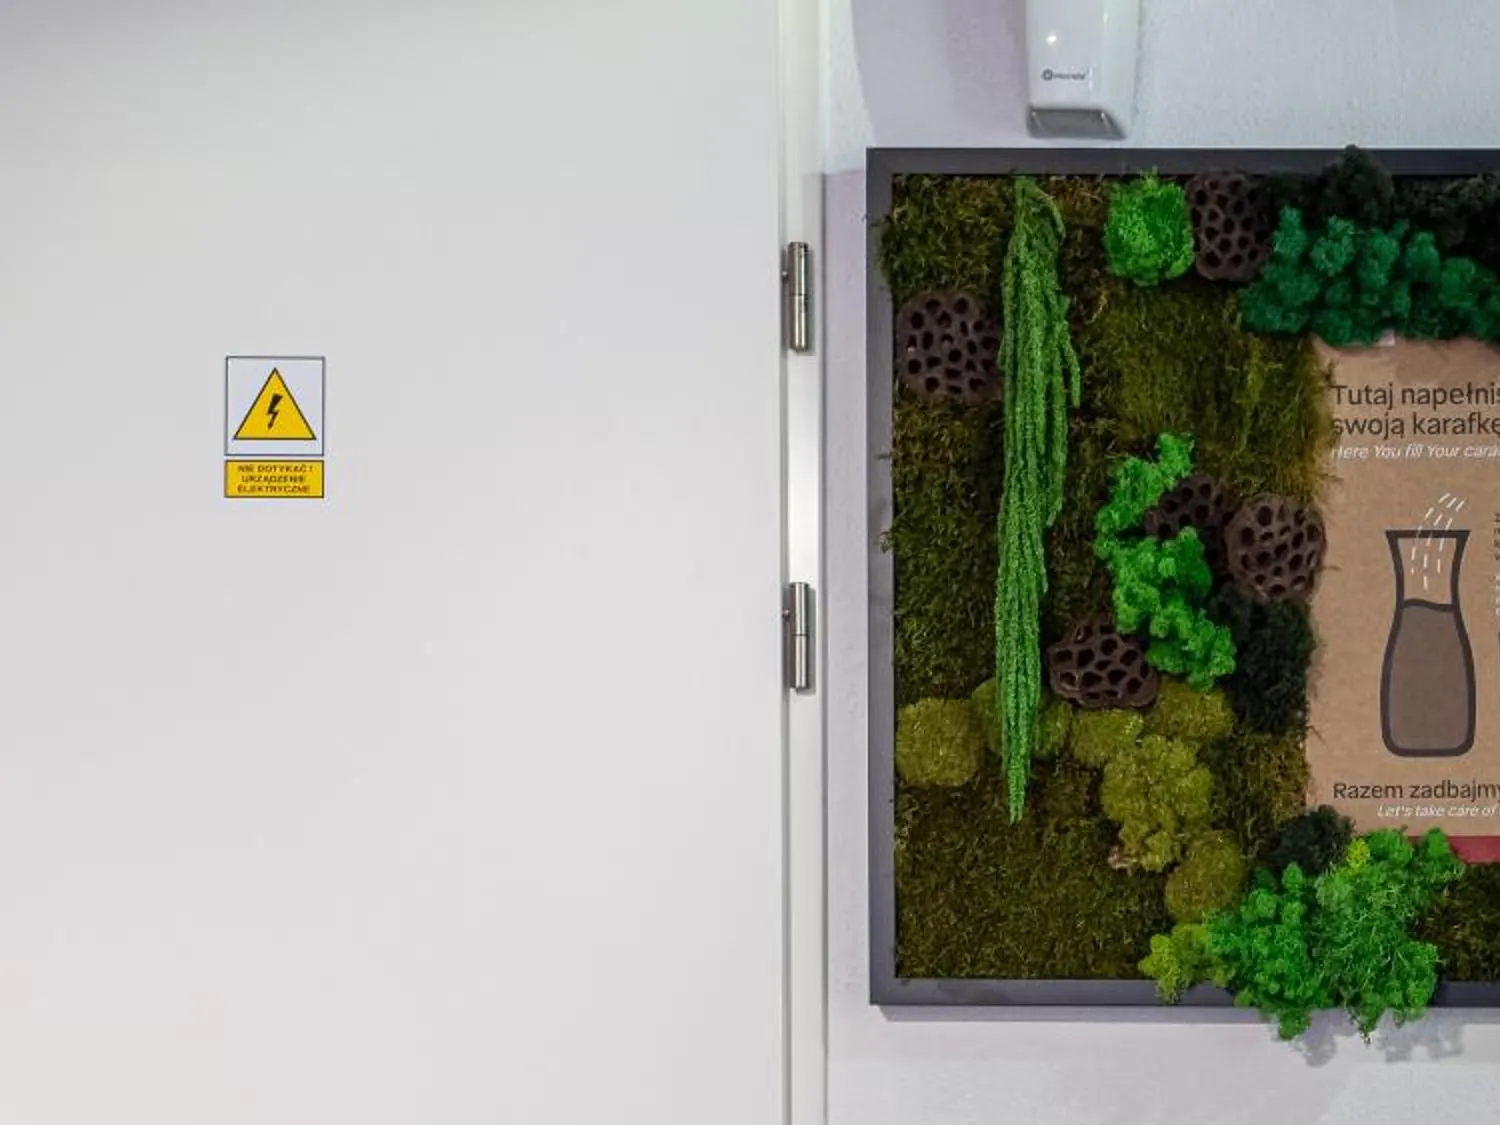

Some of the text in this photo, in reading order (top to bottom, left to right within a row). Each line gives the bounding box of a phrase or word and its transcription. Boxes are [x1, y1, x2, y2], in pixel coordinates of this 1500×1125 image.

[1331, 382, 1394, 411] Tutaj
[1332, 412, 1405, 441] swoją
[1373, 444, 1401, 458] You
[1404, 443, 1424, 458] fill
[1425, 444, 1461, 458] Your
[1333, 782, 1404, 799] Razem
[1377, 804, 1414, 817] Let's
[1415, 804, 1446, 817] take
[1447, 806, 1479, 817] care
[1481, 804, 1499, 817] of
